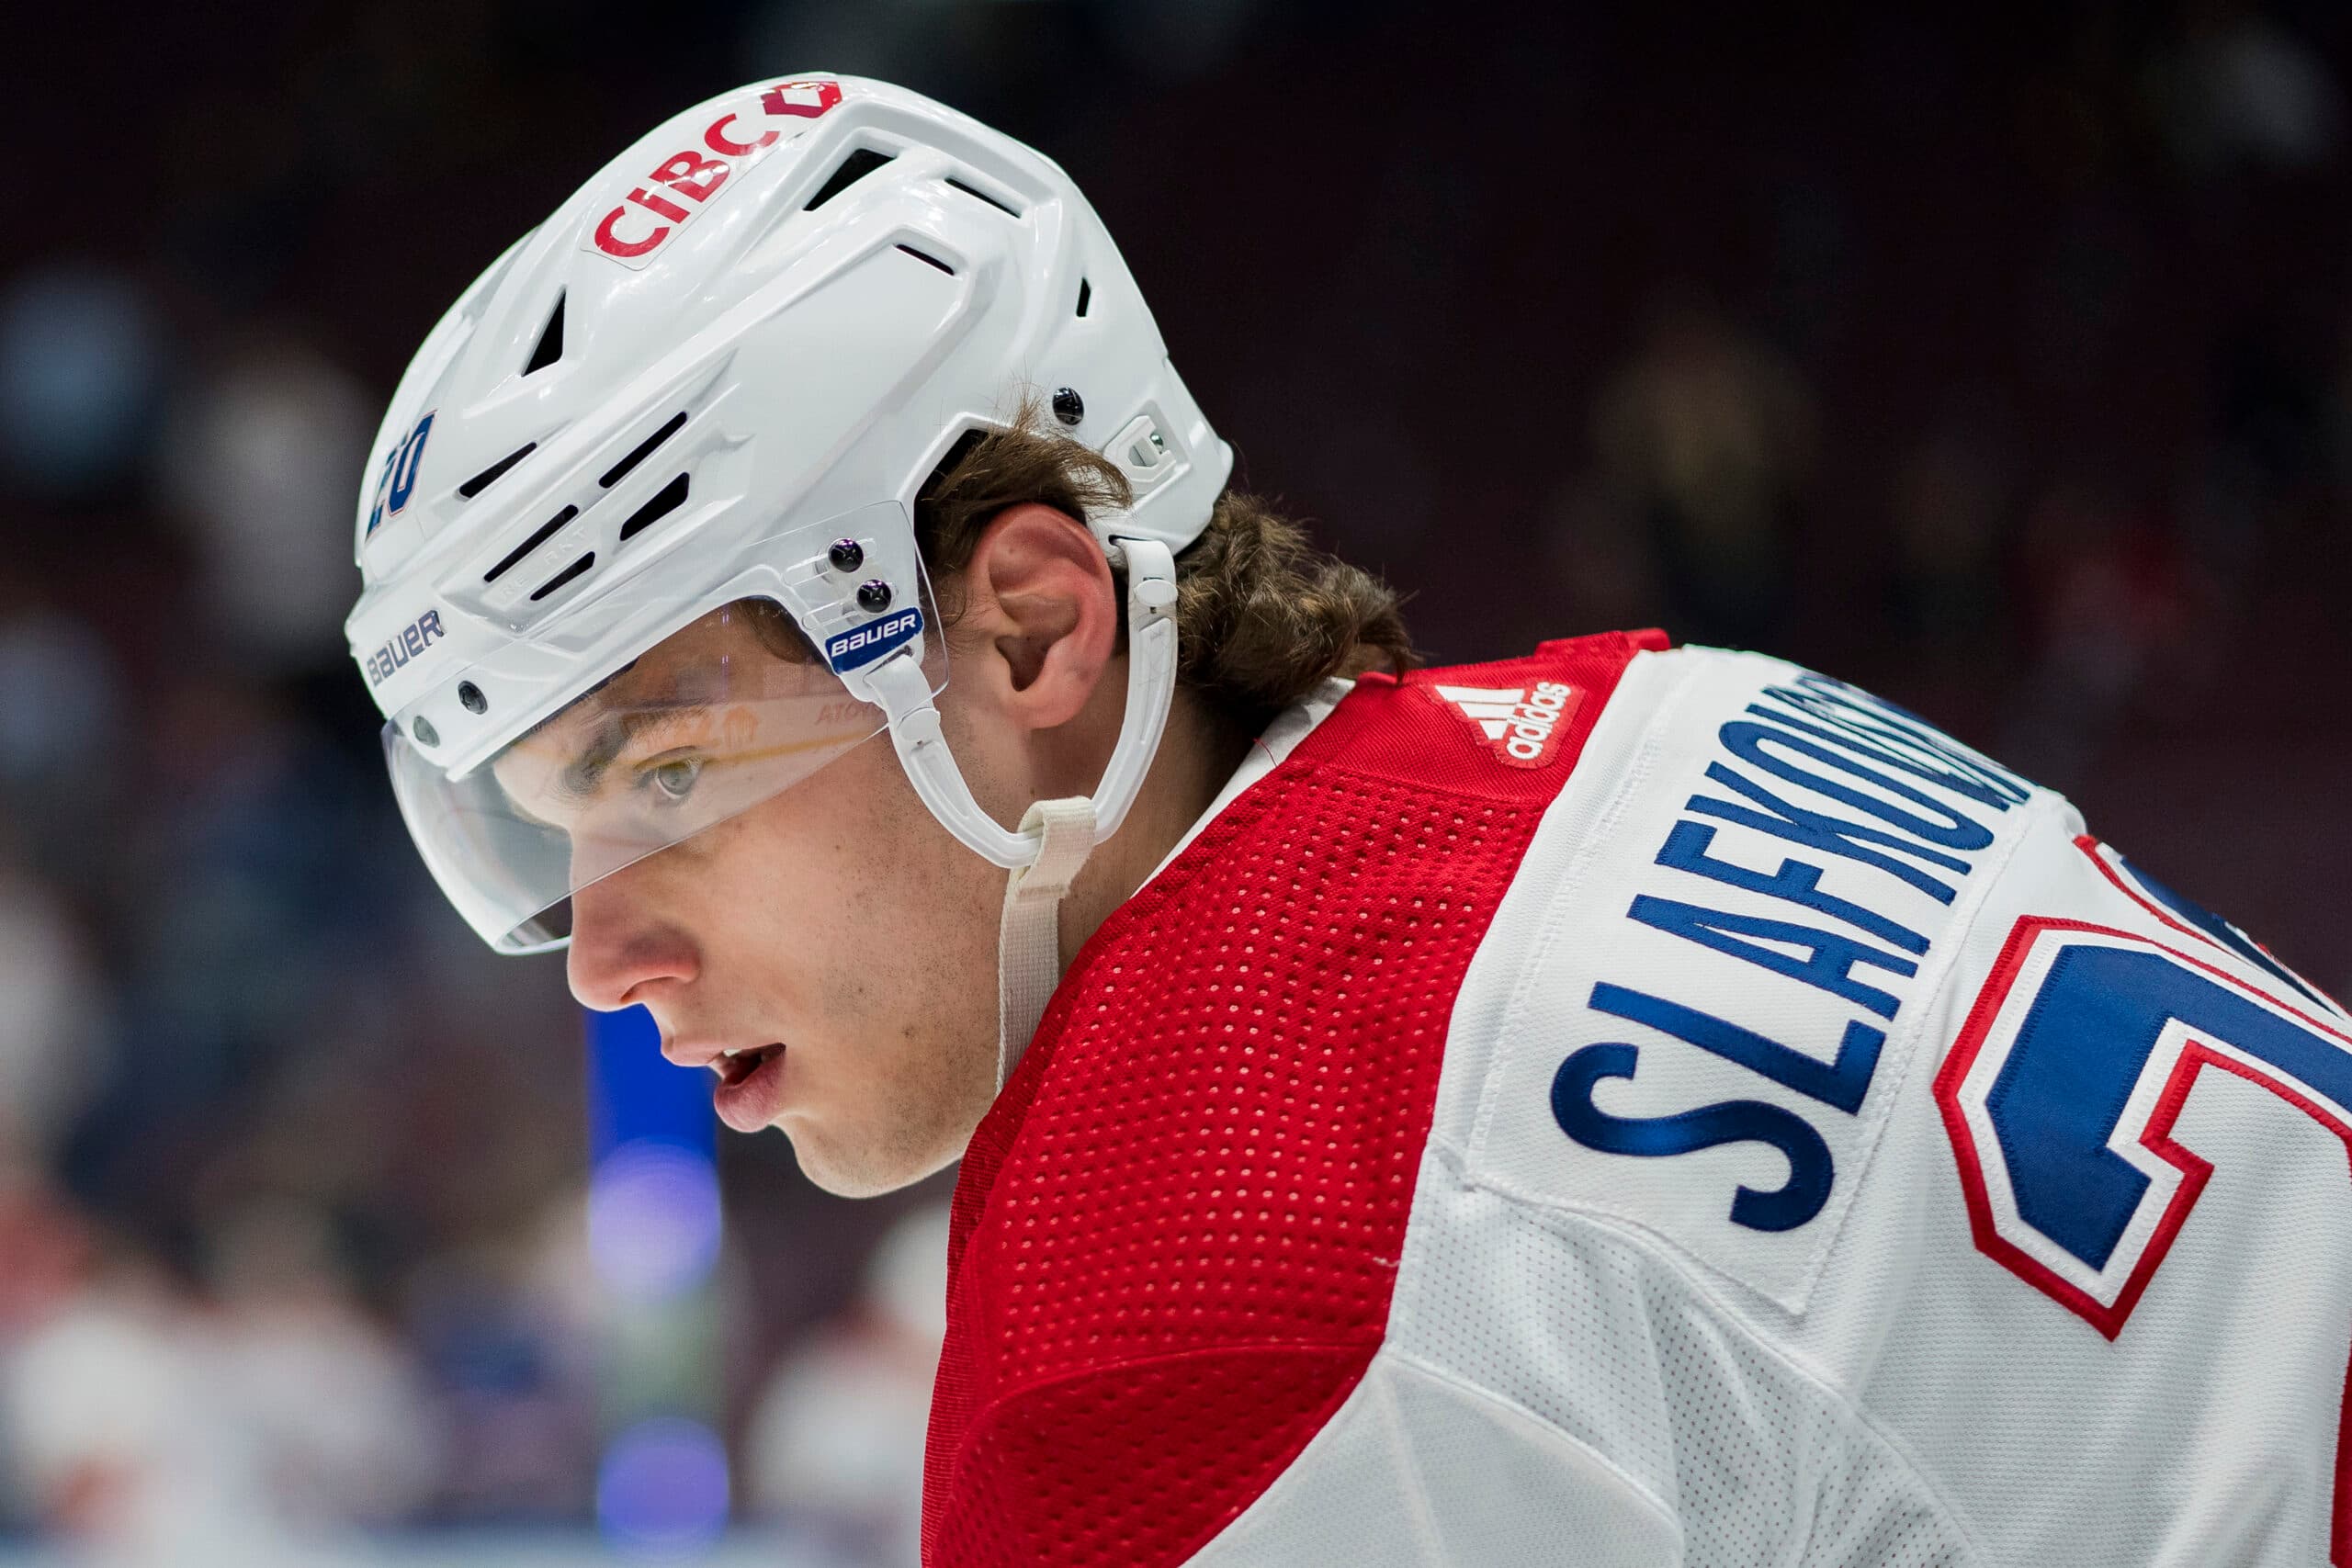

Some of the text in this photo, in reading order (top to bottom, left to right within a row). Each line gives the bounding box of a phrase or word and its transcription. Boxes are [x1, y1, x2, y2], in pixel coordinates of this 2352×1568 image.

[594, 112, 780, 258] CIBC
[367, 609, 445, 688] BAUER
[831, 614, 916, 658] BAUER
[1506, 681, 1571, 760] adidas
